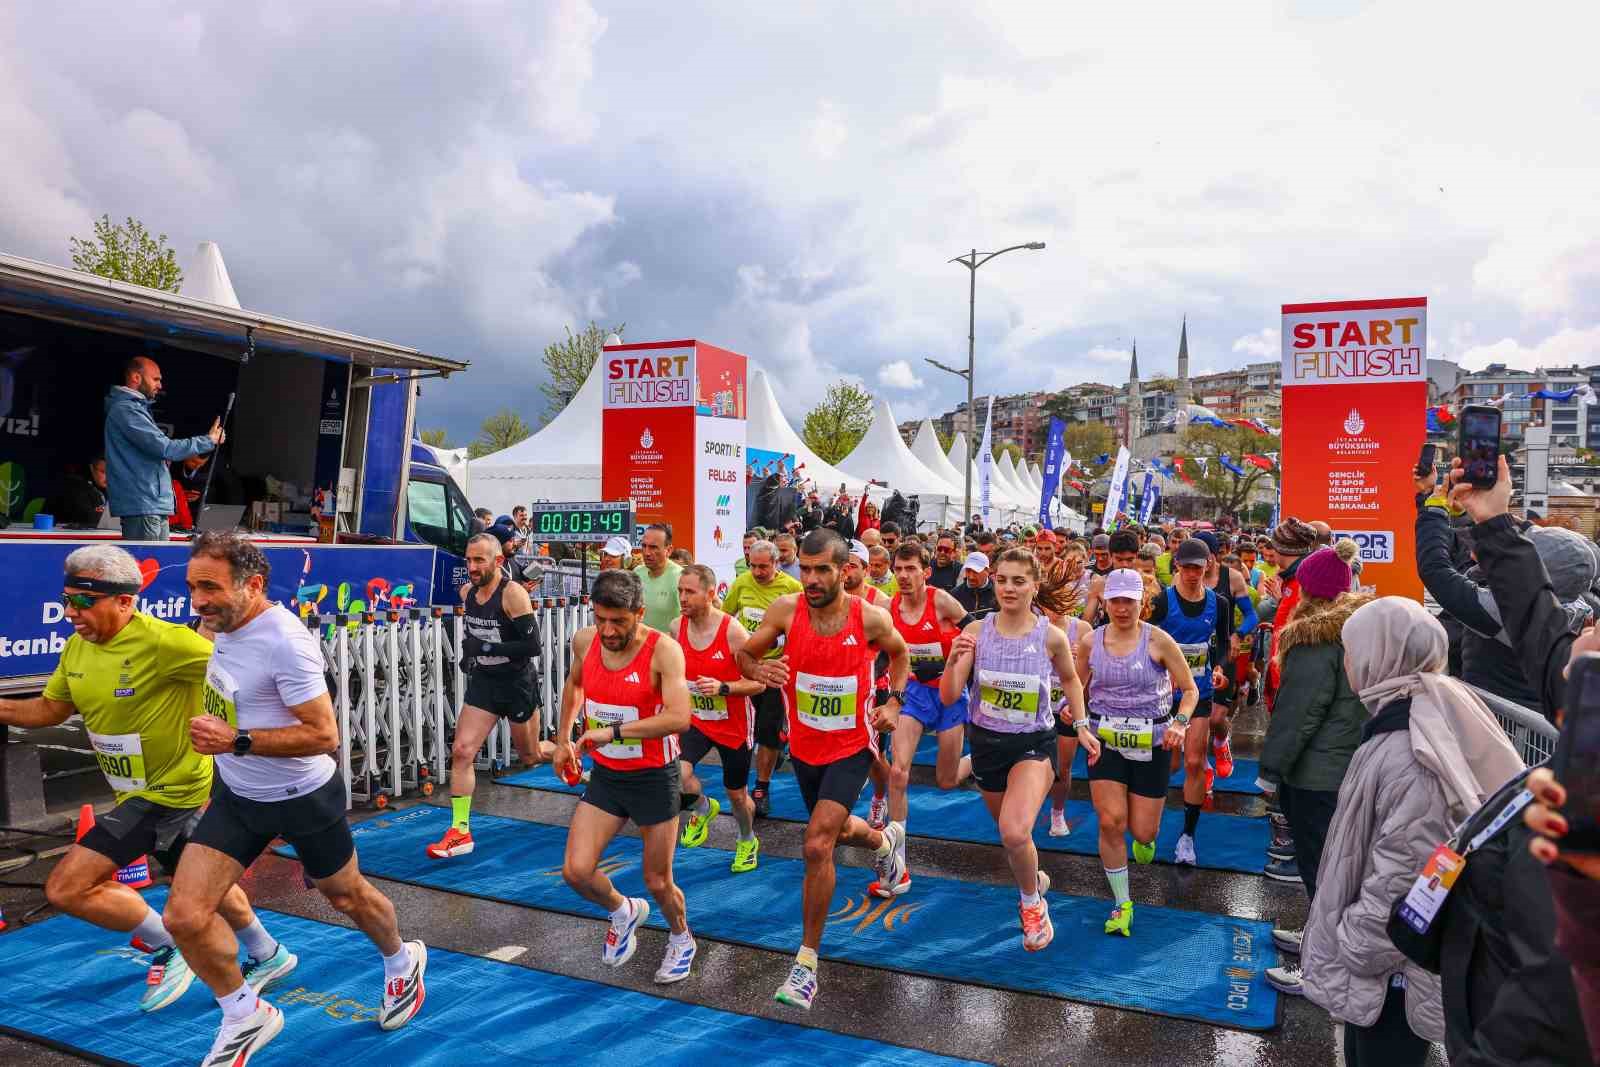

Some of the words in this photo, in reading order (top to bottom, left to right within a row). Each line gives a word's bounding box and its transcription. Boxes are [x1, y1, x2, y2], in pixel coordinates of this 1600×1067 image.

[1293, 318, 1419, 349] START
[608, 356, 689, 380] START
[1295, 348, 1420, 378] FINISH
[608, 379, 690, 403] FINISH
[1328, 470, 1366, 478] GENÇLİK
[1328, 501, 1380, 510] BAŞKANLIĞI
[540, 512, 622, 533] 00:03:49
[452, 567, 470, 578] SP
[139, 596, 186, 618] ktif
[0, 632, 68, 657] tanb
[810, 694, 842, 717] 780
[993, 688, 1024, 711] 782
